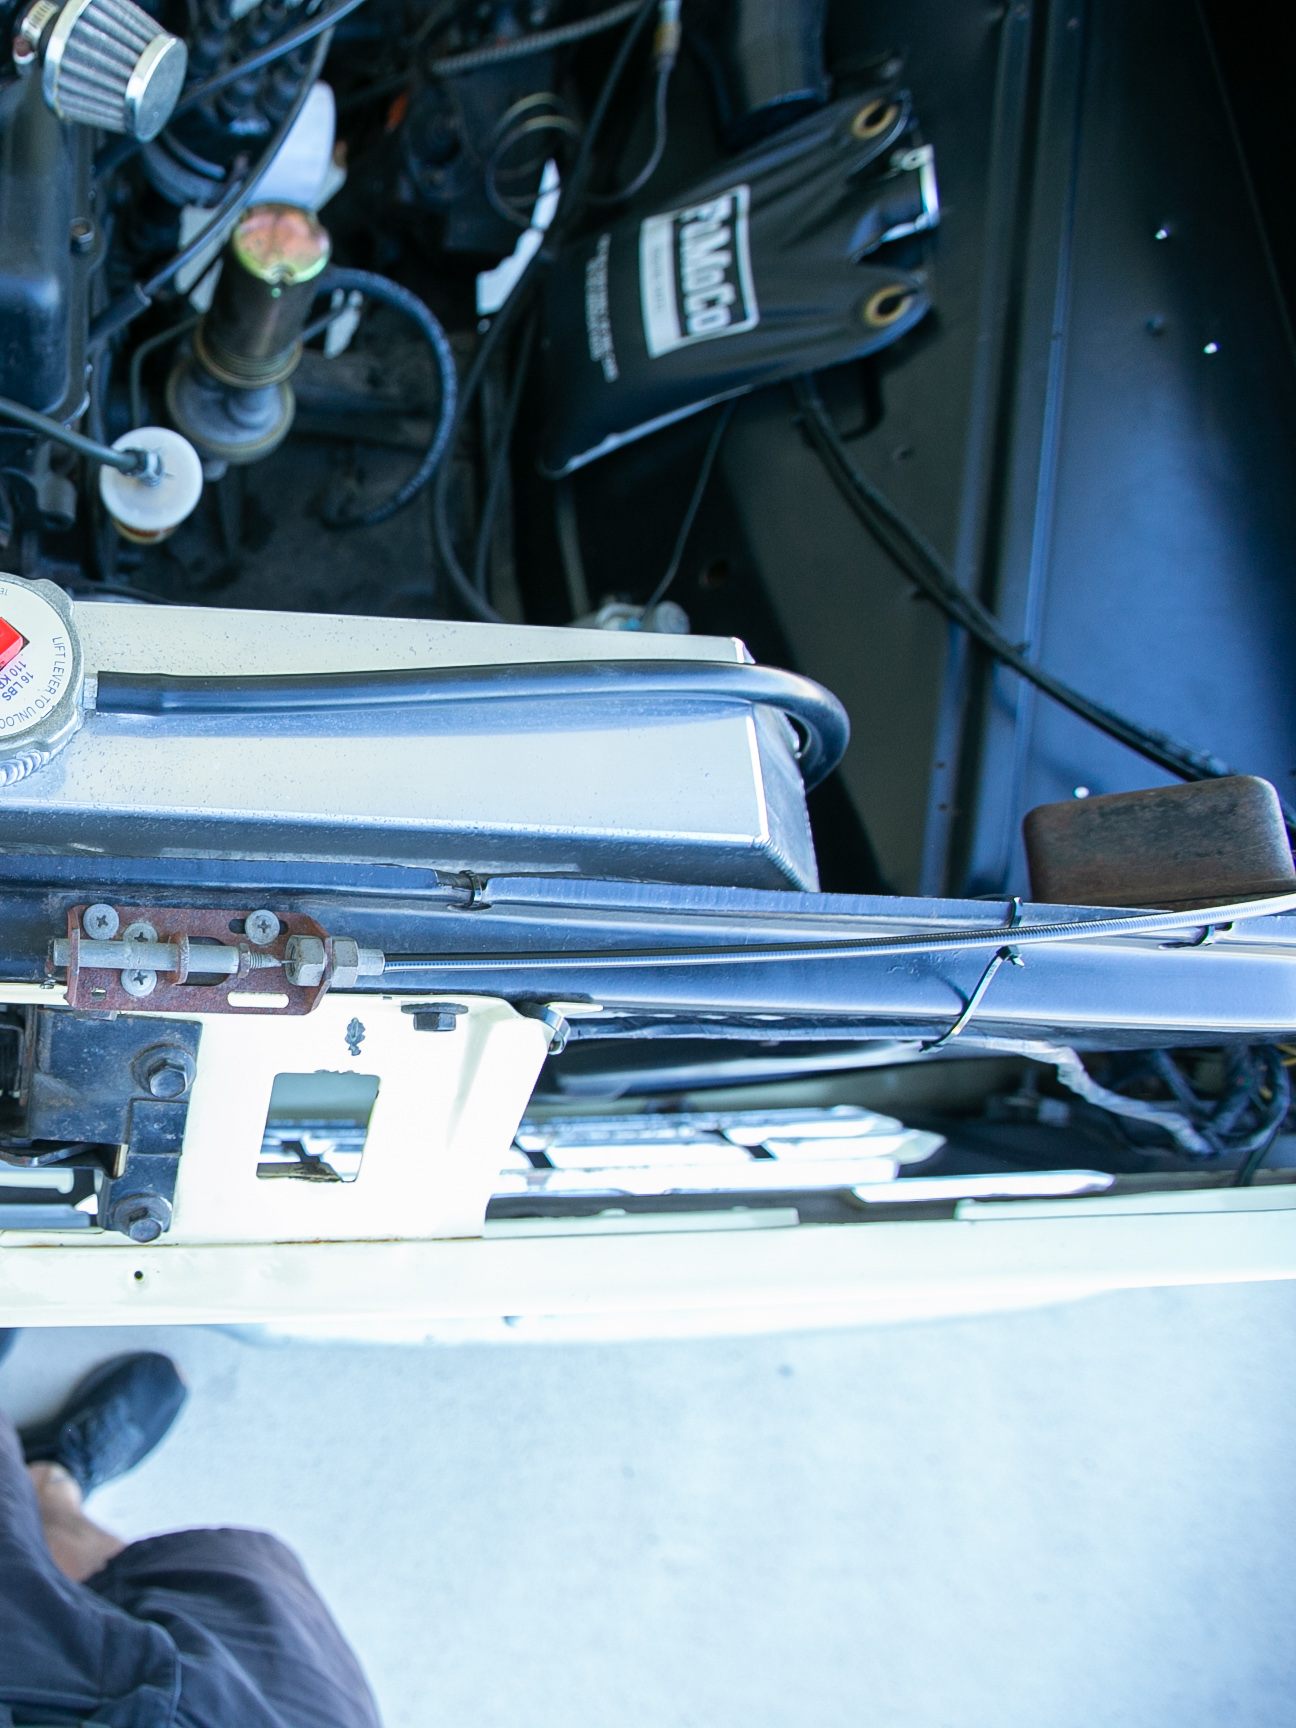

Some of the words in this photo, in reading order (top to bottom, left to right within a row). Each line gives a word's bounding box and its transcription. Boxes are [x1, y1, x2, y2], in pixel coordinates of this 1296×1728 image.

[51, 636, 66, 659] LIFT
[8, 660, 27, 677] 110
[20, 671, 34, 684] 16
[44, 660, 66, 695] LEVER
[1, 681, 24, 702] LBS
[34, 695, 51, 709] TO
